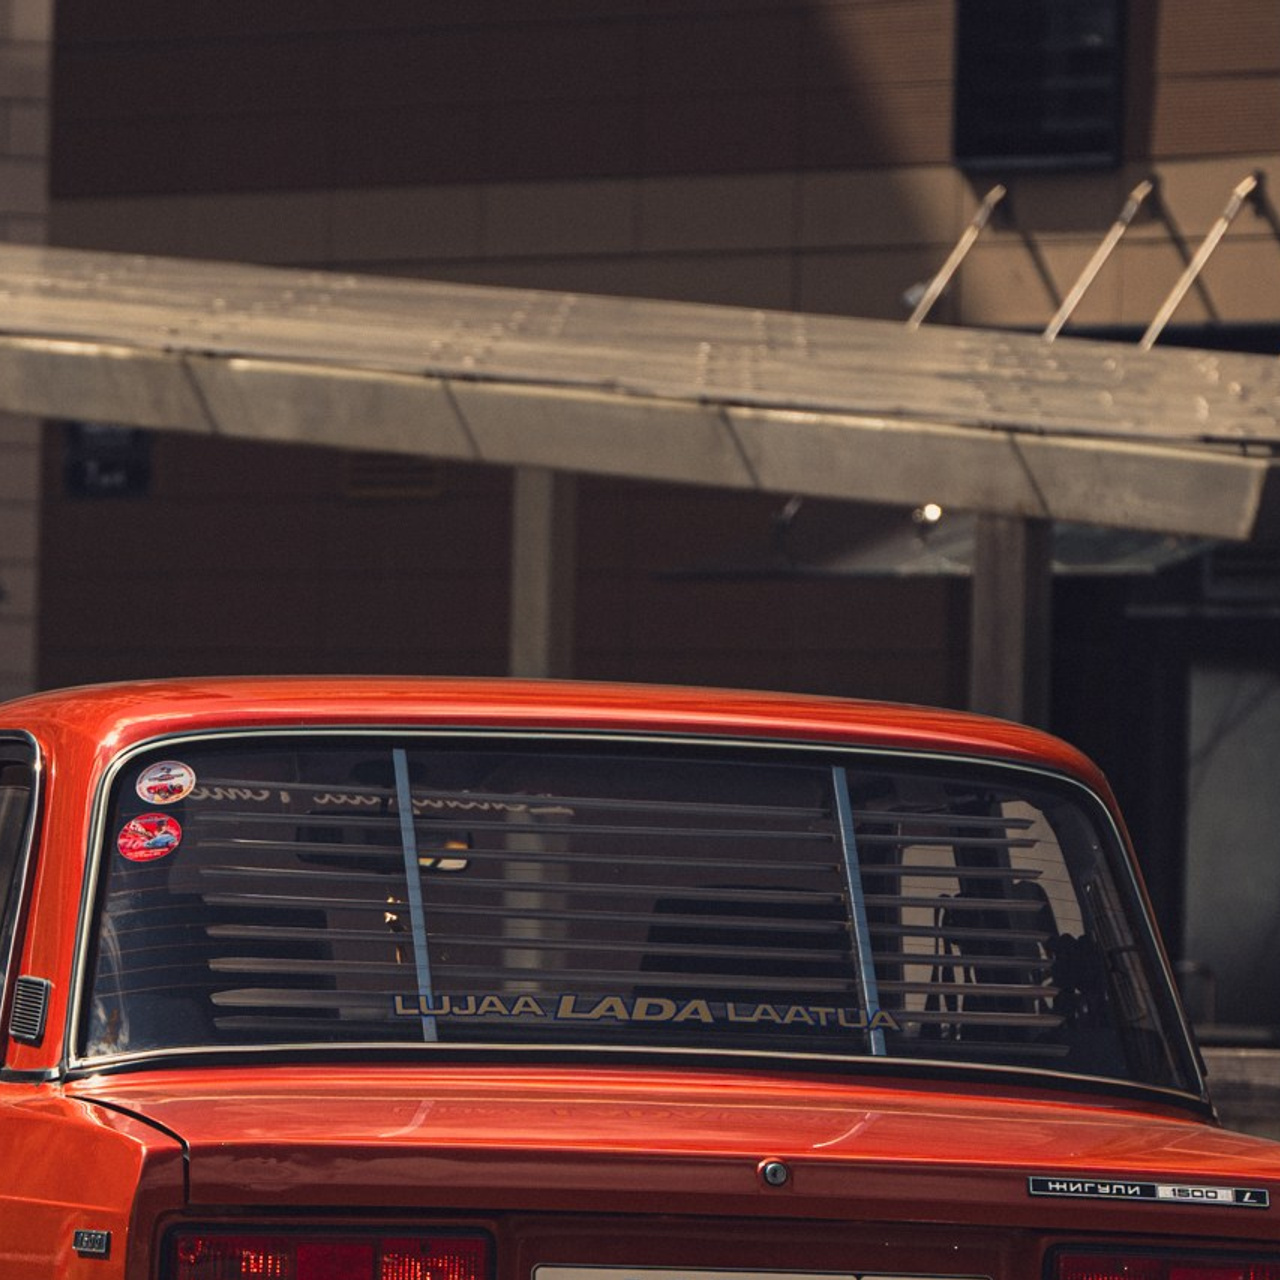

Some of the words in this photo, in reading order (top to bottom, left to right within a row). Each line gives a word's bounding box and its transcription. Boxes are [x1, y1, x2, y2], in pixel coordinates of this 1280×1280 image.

[394, 993, 545, 1017] LUJAA
[557, 995, 715, 1023] LADA
[726, 1002, 901, 1031] LAATUA
[1047, 1181, 1141, 1196] ЖИГУЛИ
[1171, 1187, 1218, 1200] 1500
